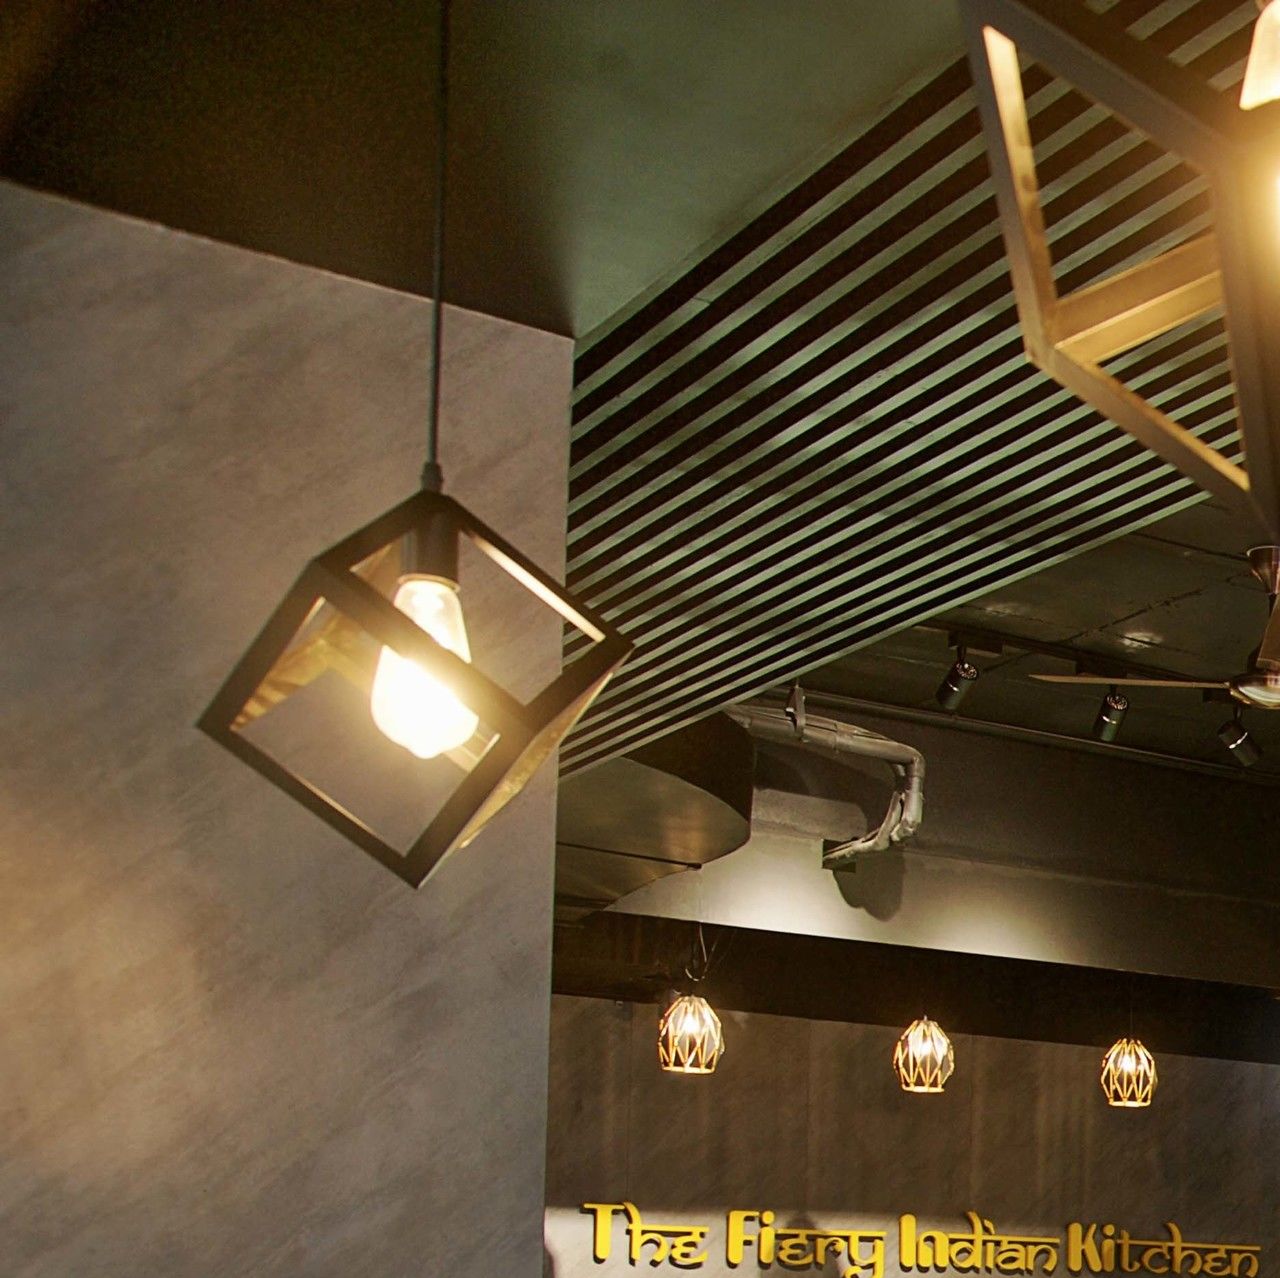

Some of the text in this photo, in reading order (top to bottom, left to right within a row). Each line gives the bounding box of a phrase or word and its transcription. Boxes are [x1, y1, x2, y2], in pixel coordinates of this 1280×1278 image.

[582, 1200, 708, 1266] The
[897, 1208, 1063, 1274] Indian
[1066, 1221, 1262, 1278] Kitchen
